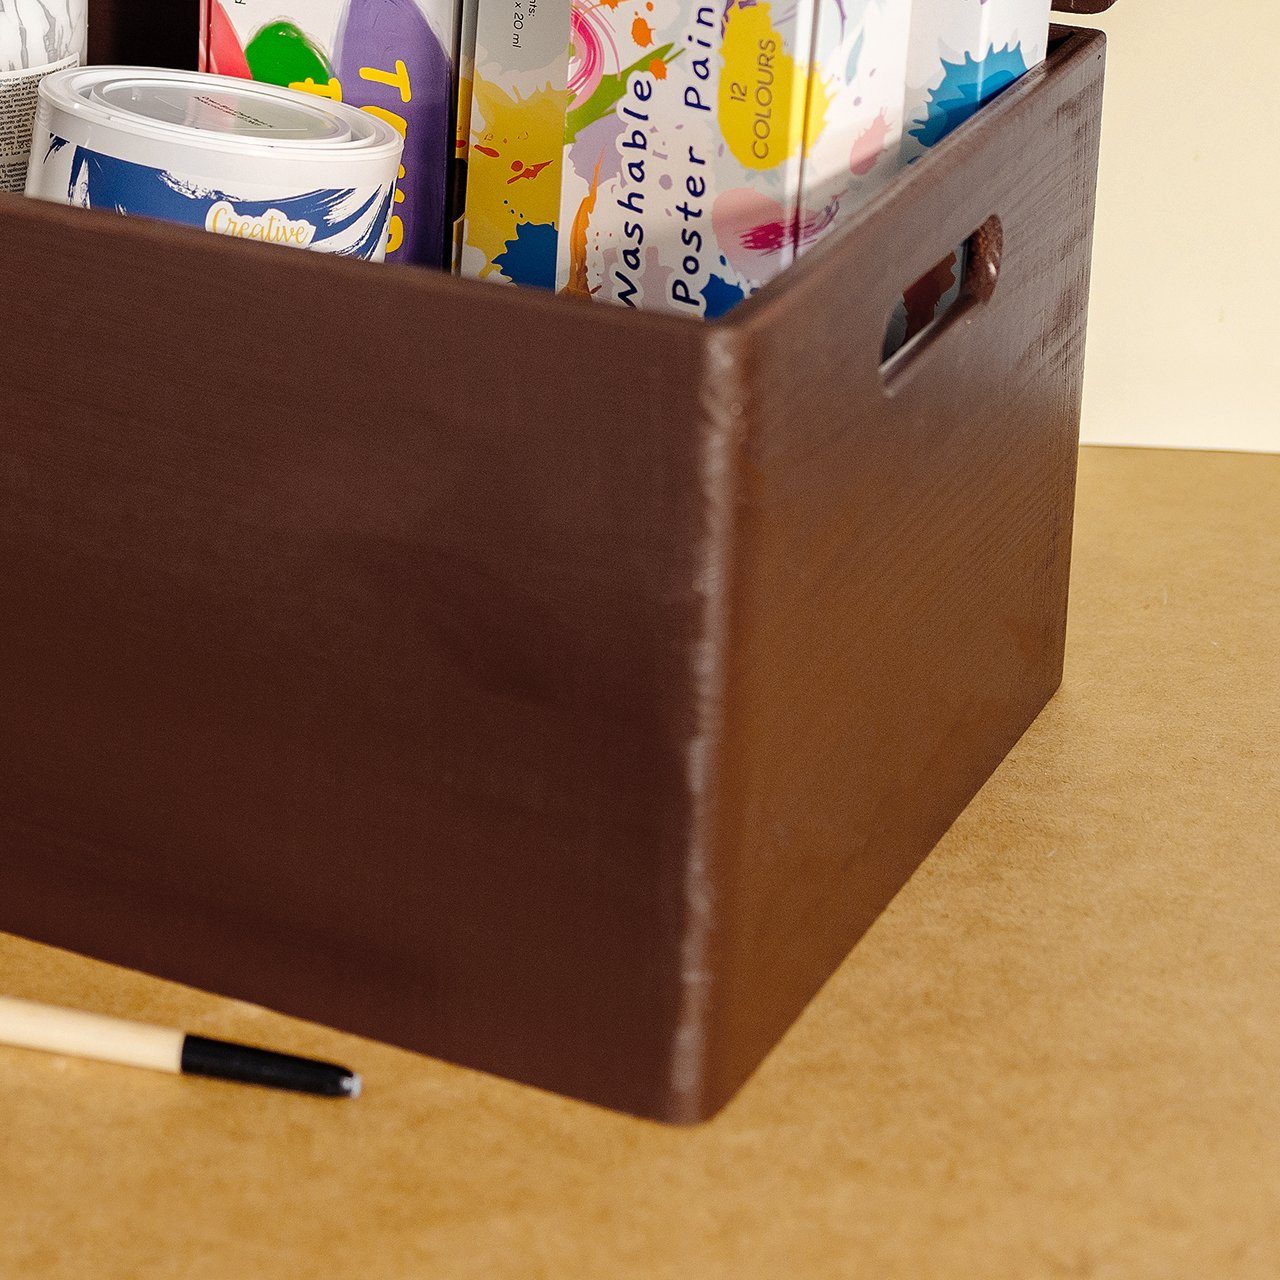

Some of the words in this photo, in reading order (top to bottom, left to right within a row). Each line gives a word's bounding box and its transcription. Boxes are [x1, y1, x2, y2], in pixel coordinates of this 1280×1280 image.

[513, 14, 524, 30] 20
[512, 32, 522, 49] ml
[730, 81, 747, 103] 12
[752, 38, 777, 160] COLOURS
[617, 78, 653, 309] Washable
[212, 207, 308, 243] Creative
[671, 145, 707, 307] Poster
